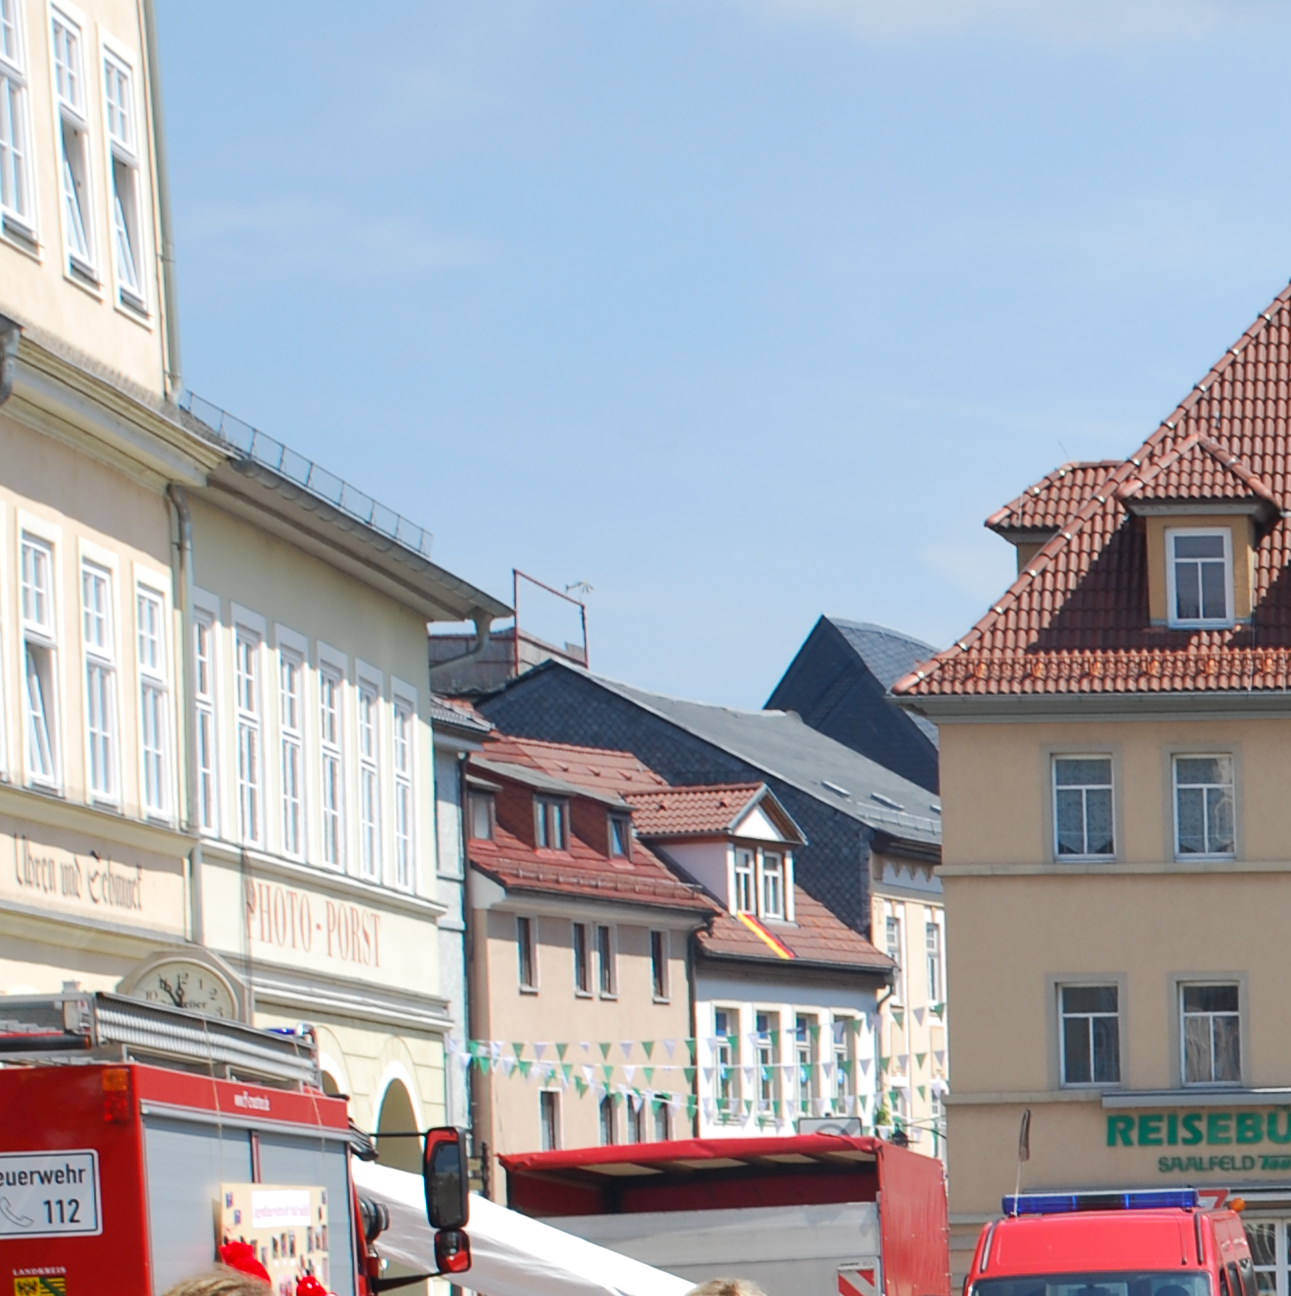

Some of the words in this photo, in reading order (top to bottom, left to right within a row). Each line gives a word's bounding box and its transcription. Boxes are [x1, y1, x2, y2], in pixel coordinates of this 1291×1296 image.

[326, 900, 381, 968] PORST
[1158, 1155, 1255, 1172] SAALFELD
[43, 1198, 81, 1225] 112
